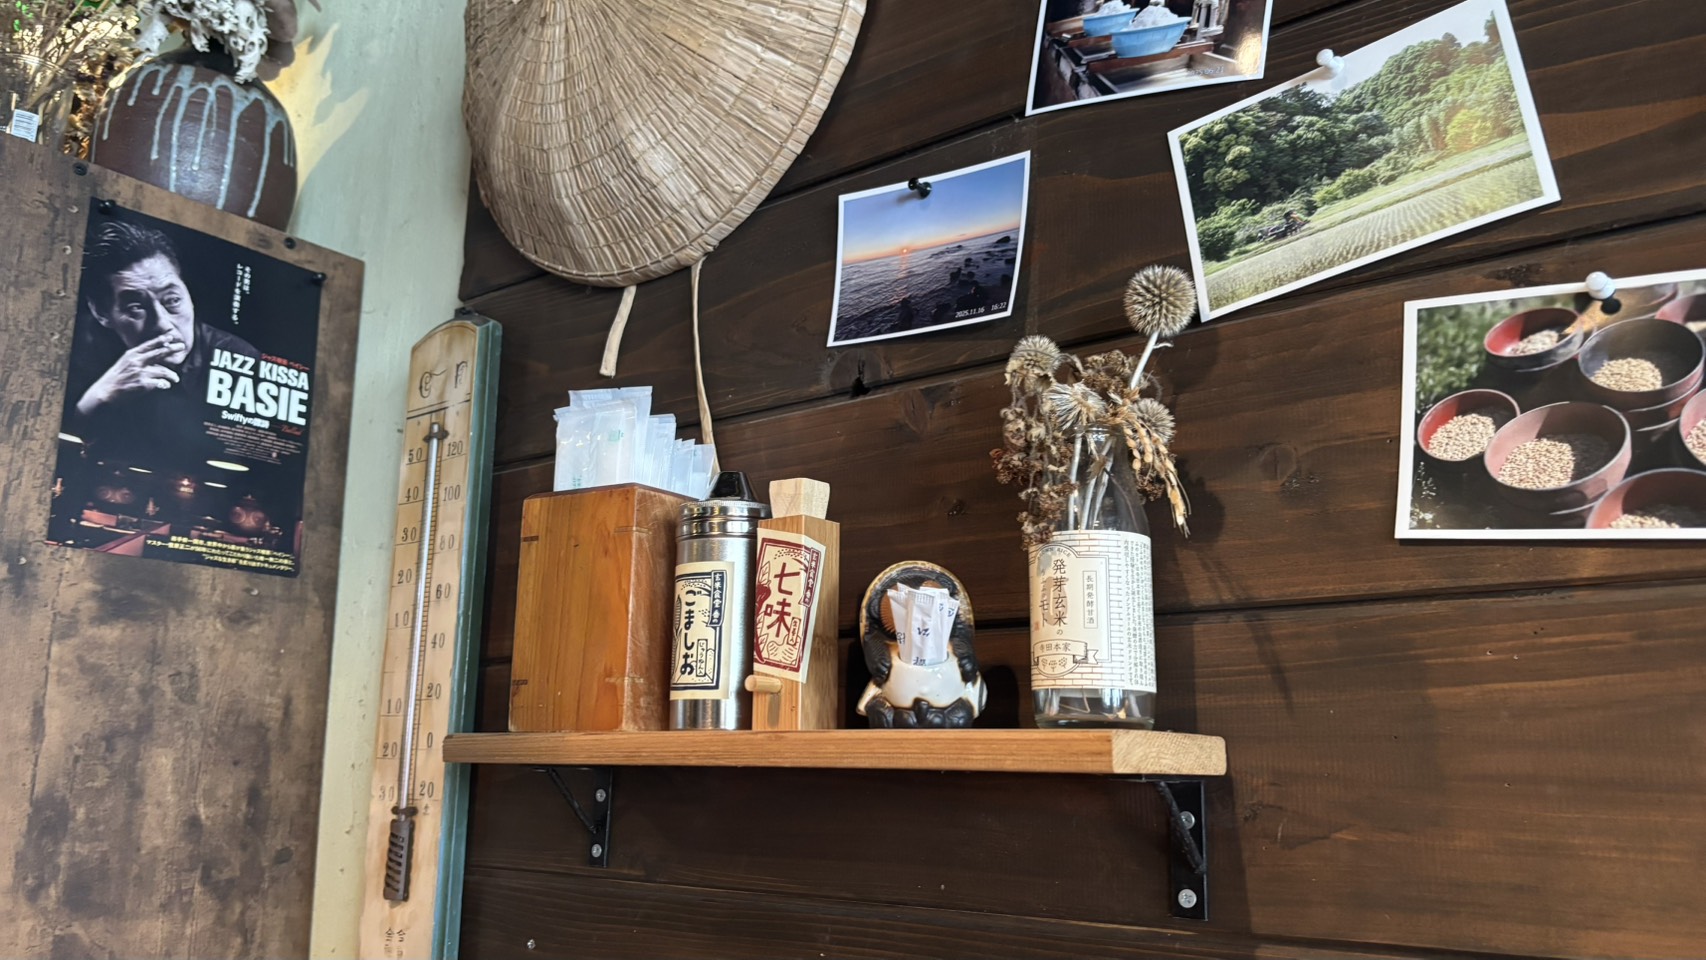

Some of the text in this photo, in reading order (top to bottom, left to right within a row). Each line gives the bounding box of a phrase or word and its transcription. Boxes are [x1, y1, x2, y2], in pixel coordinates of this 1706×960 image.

[209, 349, 309, 390] JAZZ KISSA
[206, 368, 308, 426] BASIE
[408, 440, 463, 462] 50 120
[405, 485, 461, 502] 40 100
[402, 527, 417, 542] 30
[397, 568, 451, 599] 20 60
[764, 562, 801, 638] 七味
[1052, 559, 1068, 635] 発芽玄米の
[1086, 575, 1095, 624] 長期発酵甘酒
[395, 611, 445, 648] 10 40
[680, 589, 702, 676] ごましお
[387, 682, 442, 714] 10 20
[383, 732, 433, 757] 20 0
[419, 781, 434, 798] 20
